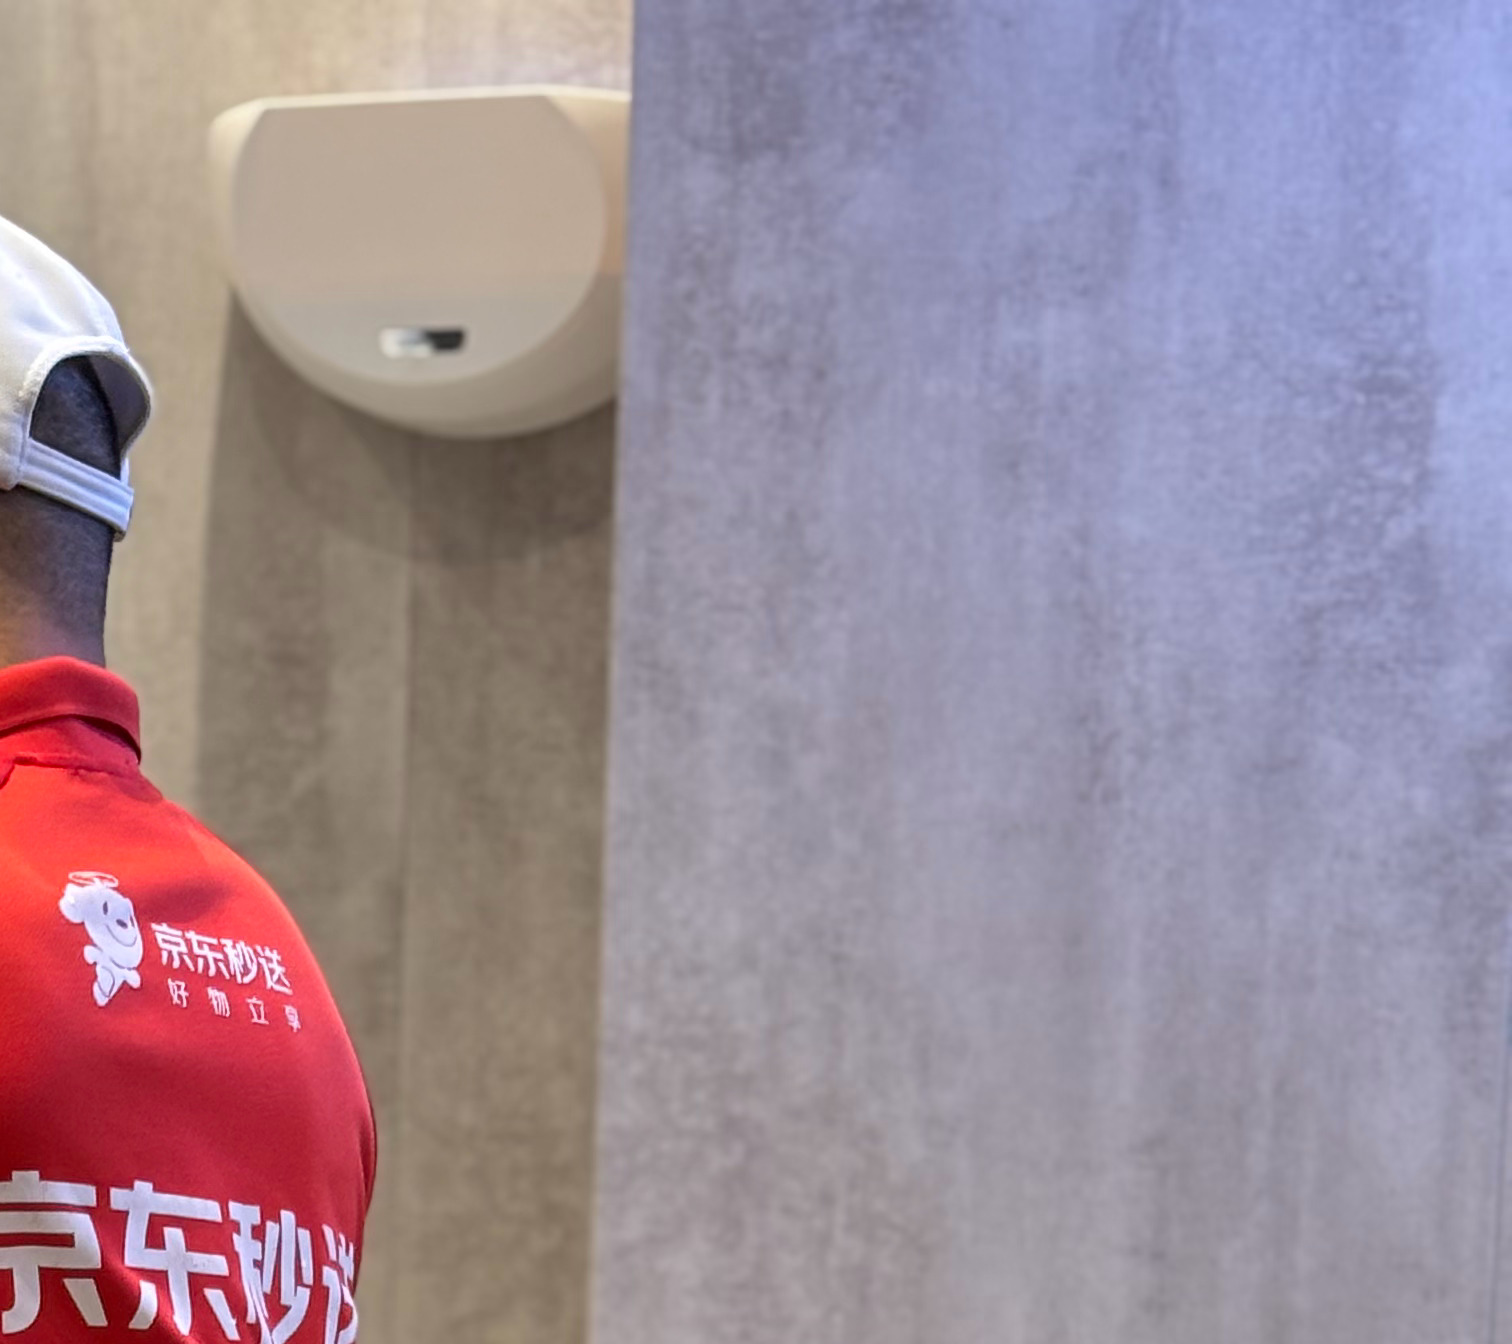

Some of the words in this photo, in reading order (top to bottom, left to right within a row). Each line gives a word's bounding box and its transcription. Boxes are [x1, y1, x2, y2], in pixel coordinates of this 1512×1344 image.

[150, 922, 294, 996] 京东秒送
[167, 976, 302, 1034] 好物立享
